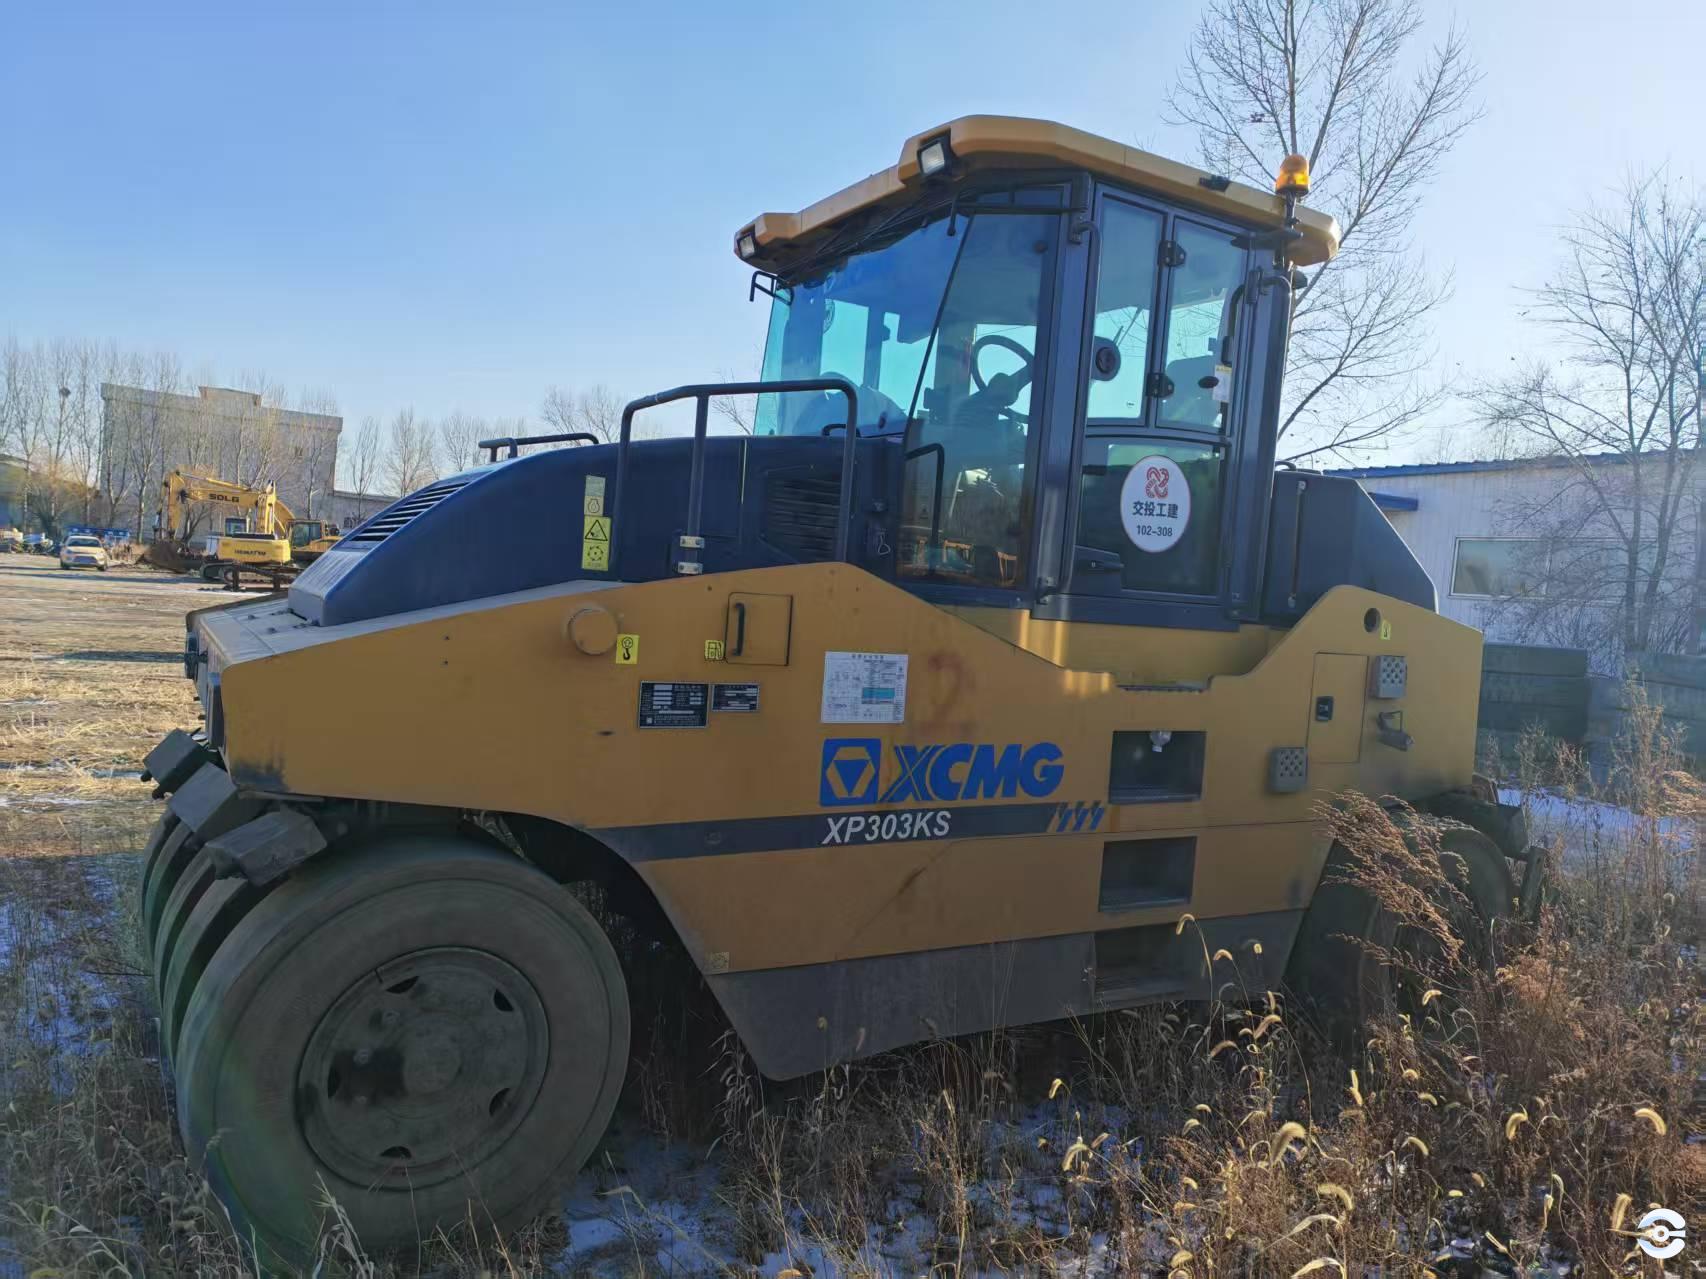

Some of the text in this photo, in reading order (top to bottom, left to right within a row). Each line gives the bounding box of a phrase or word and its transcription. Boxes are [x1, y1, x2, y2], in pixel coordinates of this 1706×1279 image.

[1132, 501, 1178, 518] 交投工建
[1137, 525, 1173, 536] 102-308
[879, 742, 1064, 801] XCMG
[822, 811, 951, 844] XP303KS
